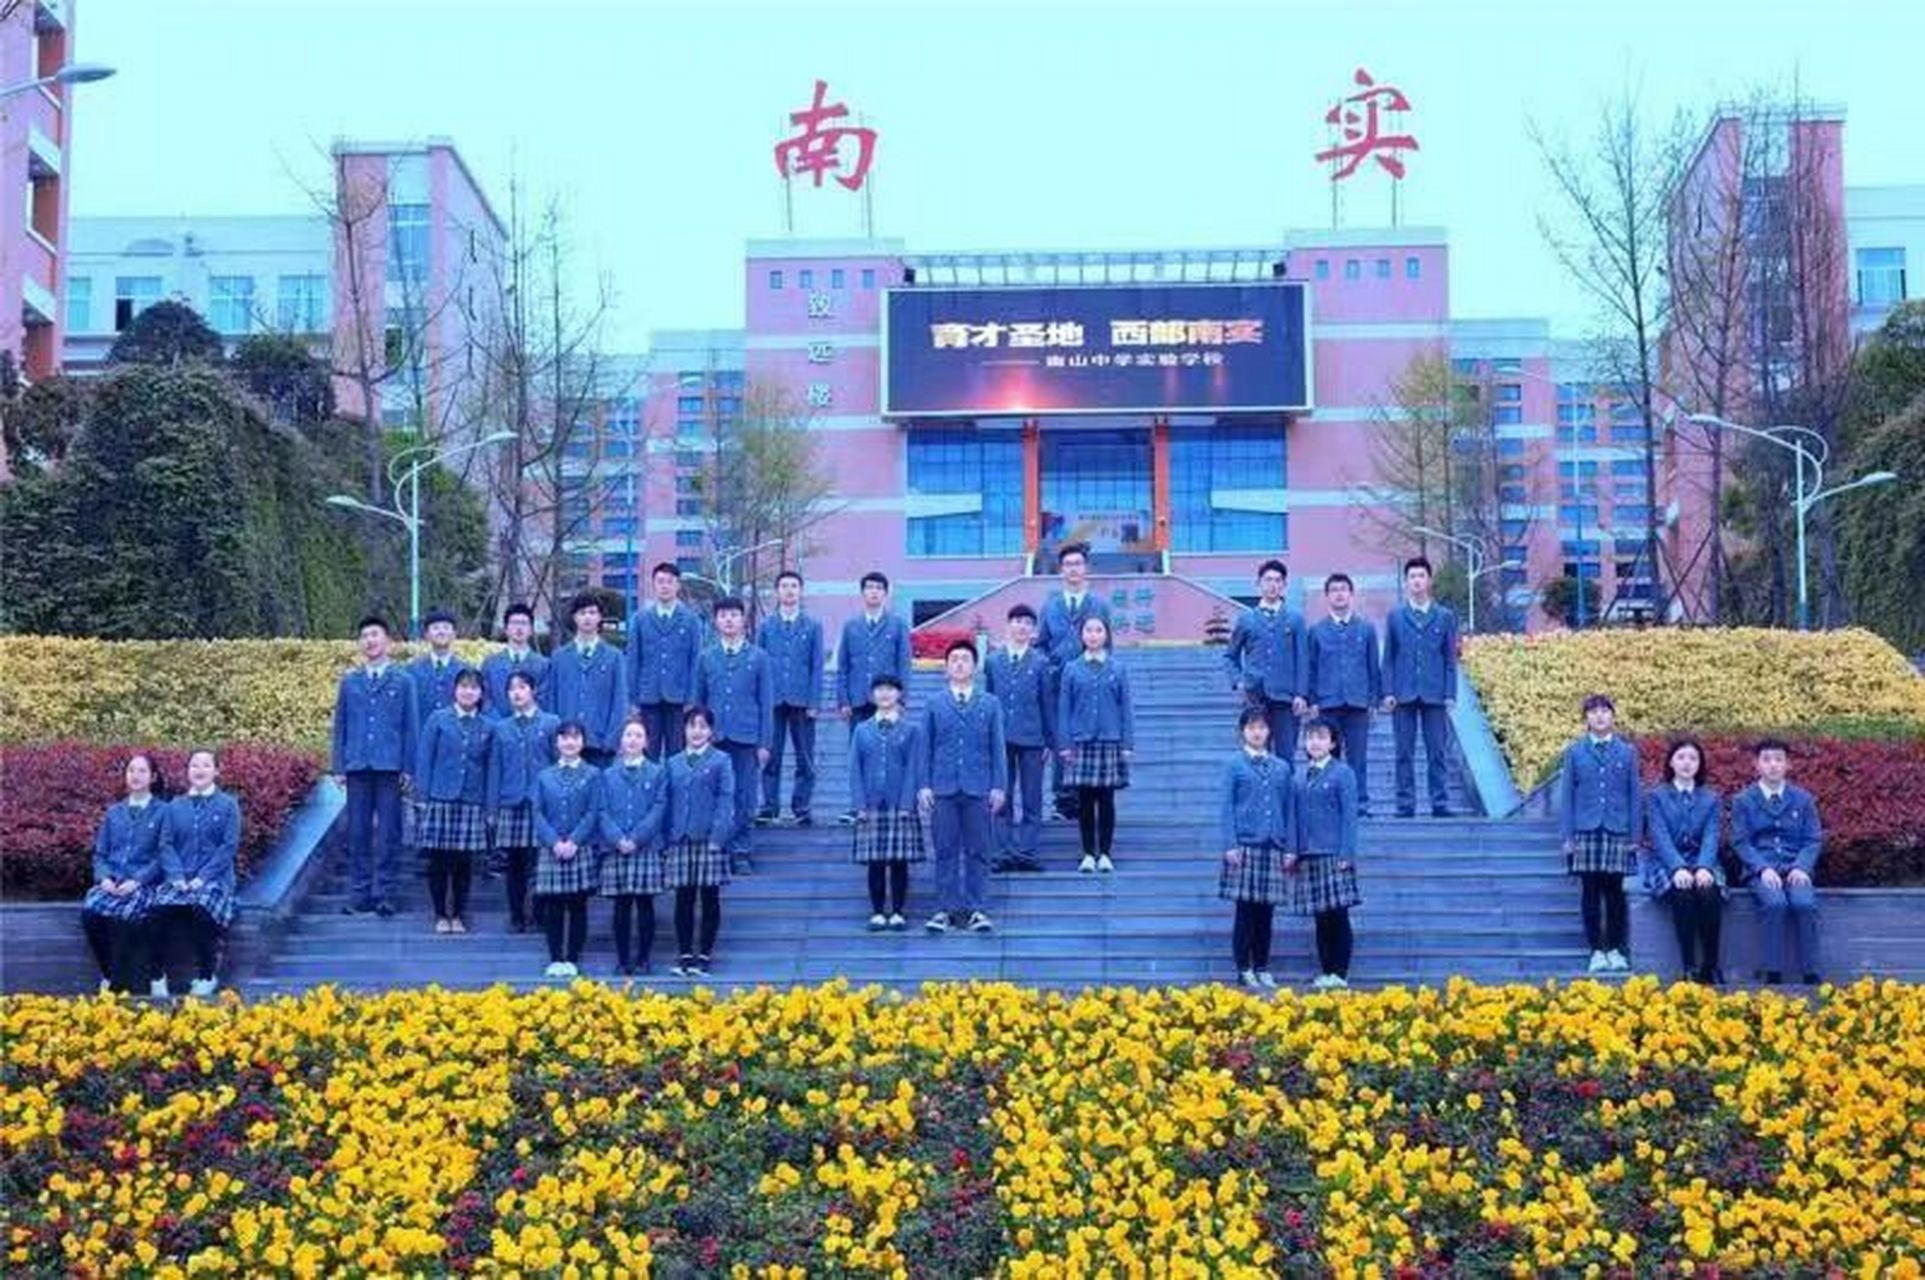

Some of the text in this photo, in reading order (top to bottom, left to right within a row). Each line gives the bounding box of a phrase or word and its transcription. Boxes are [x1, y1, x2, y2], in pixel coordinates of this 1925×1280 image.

[774, 68, 1419, 192] 南 实
[930, 320, 1265, 348] 育才圣地 西部南实
